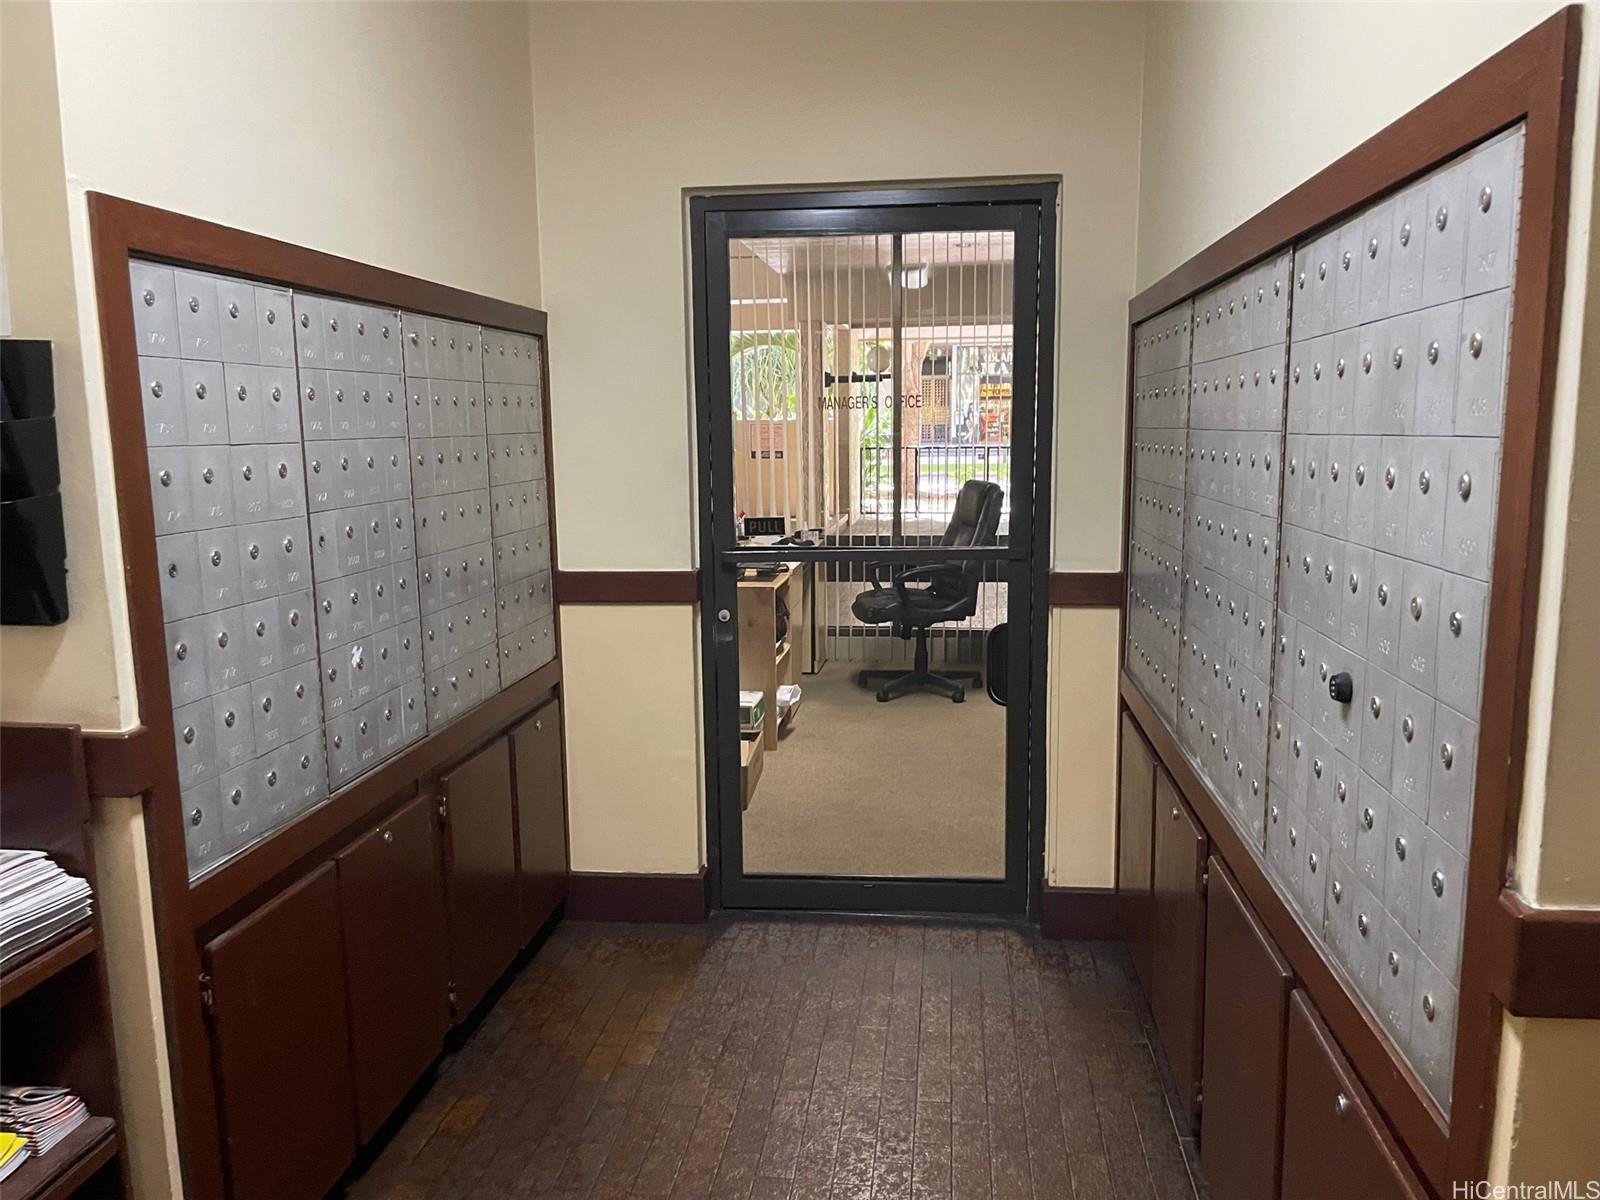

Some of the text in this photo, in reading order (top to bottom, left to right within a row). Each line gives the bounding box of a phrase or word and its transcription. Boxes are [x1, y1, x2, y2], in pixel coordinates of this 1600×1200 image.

[818, 394, 923, 409] MANAGER'S OFICE
[749, 519, 781, 534] PULL
